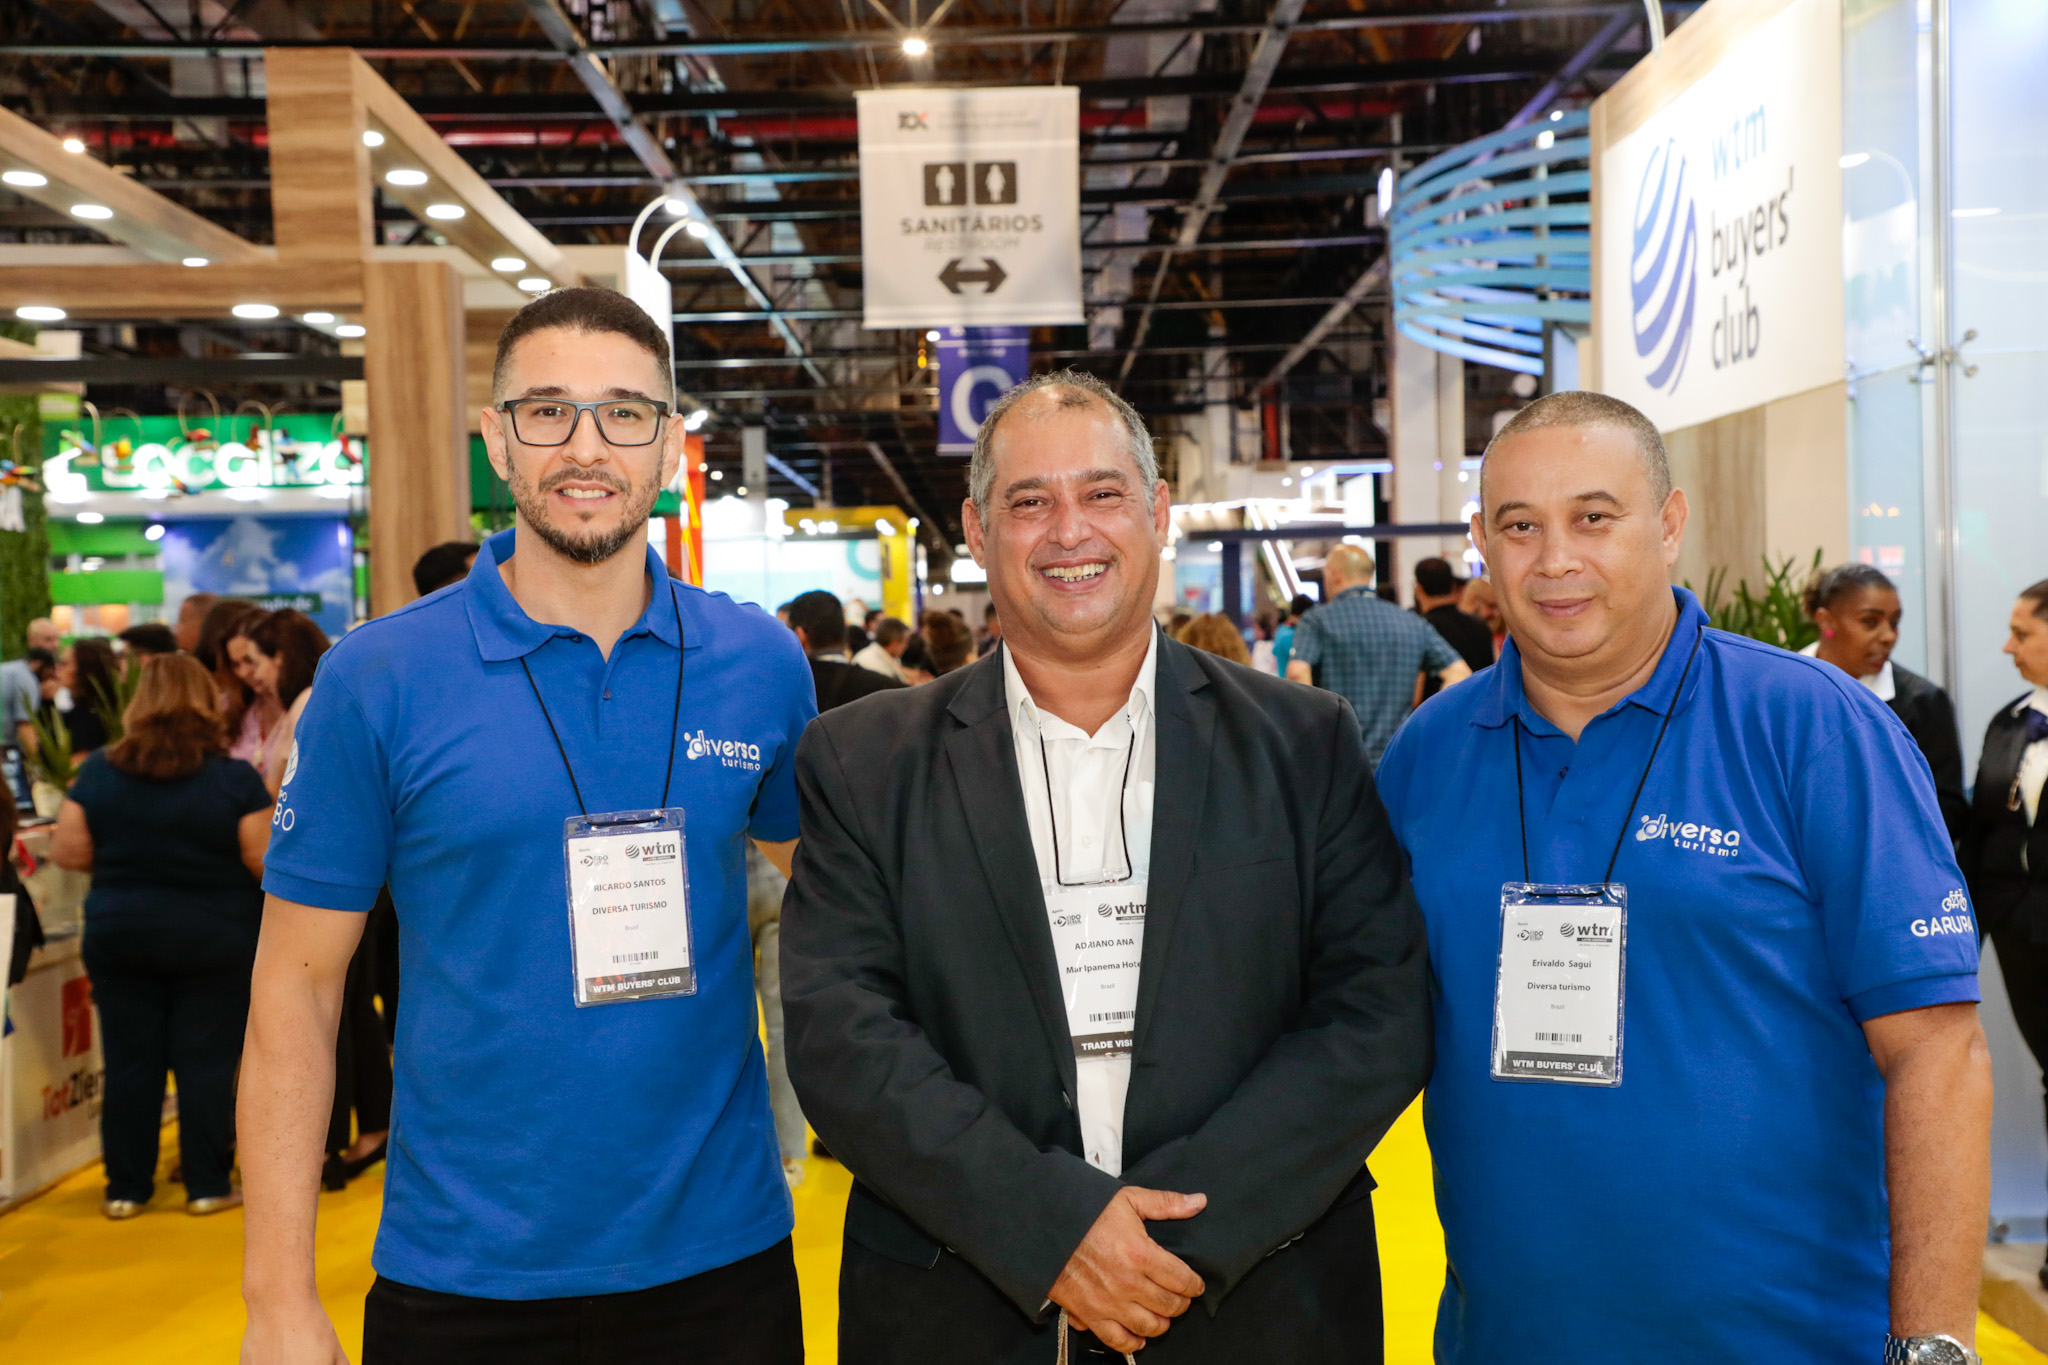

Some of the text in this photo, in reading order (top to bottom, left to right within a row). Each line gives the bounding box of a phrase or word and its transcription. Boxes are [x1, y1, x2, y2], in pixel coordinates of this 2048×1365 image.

[1711, 104, 1767, 182] wtm
[900, 212, 1043, 235] SANITÁRIOS
[1711, 285, 1760, 370] club
[684, 730, 760, 761] diversa
[722, 757, 761, 771] turismo
[1637, 814, 1740, 846] diversa
[642, 842, 676, 855] wtm
[1674, 838, 1738, 857] turismo
[594, 878, 666, 892] RICARDO SANTOS
[592, 901, 668, 915] DIVERSA TURISMO
[1577, 923, 1613, 936] wtm
[1075, 938, 1135, 950] ADRIANO ANA
[1066, 966, 1083, 974] Mar
[1084, 963, 1121, 974] Ipanema
[1532, 959, 1592, 970] Erivaldo Sagui
[592, 976, 681, 994] WTM BUYERS' CLUB
[1527, 981, 1591, 991] Diversa turismo
[1081, 1040, 1114, 1051] TRADE
[1512, 1060, 1604, 1072] WTM BUYERS' CLUB
